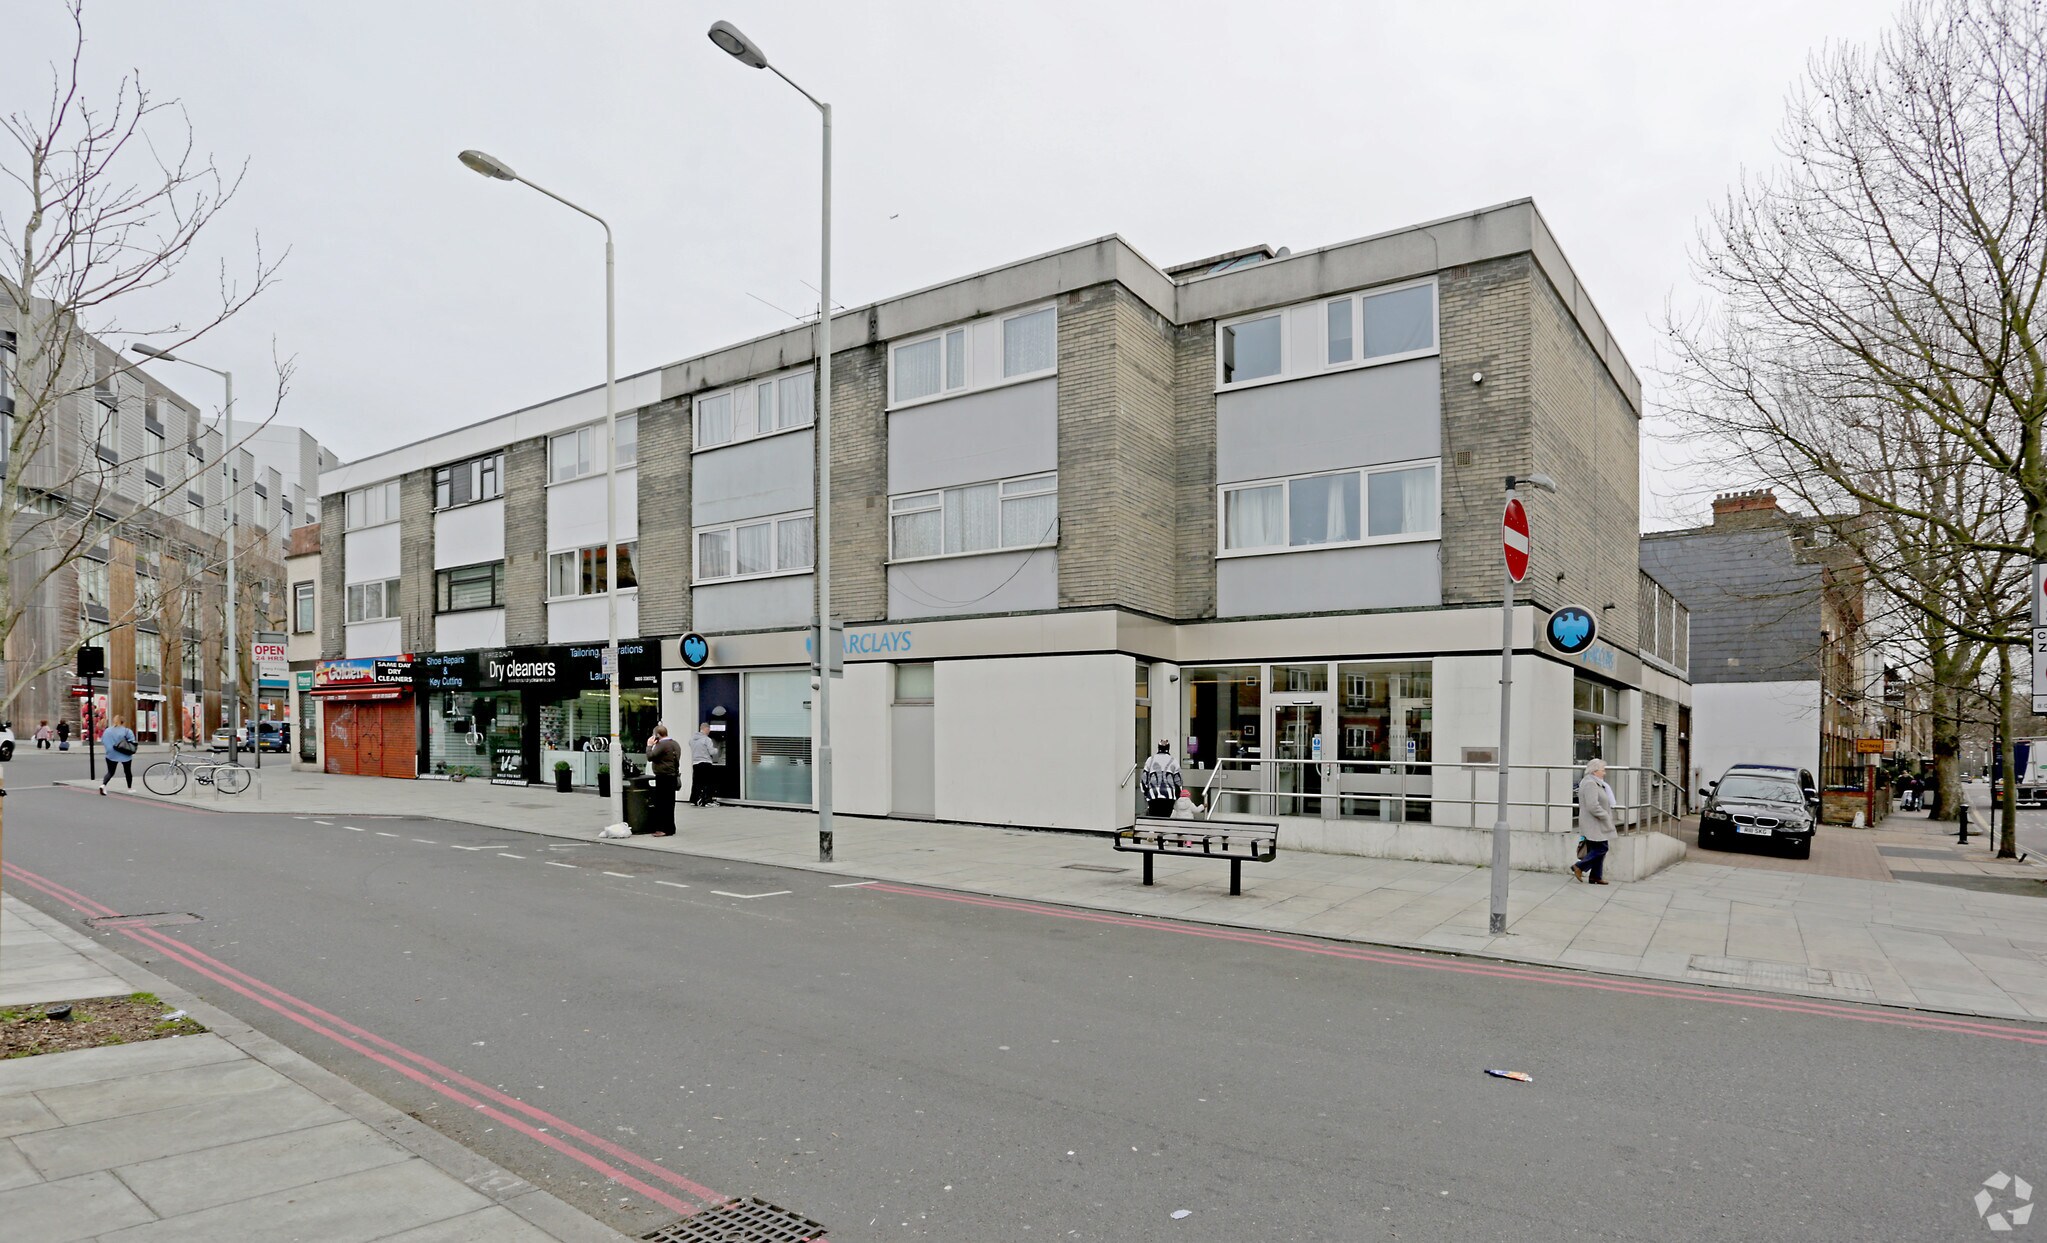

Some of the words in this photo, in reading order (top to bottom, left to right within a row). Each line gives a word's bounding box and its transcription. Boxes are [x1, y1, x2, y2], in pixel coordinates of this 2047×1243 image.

[843, 630, 912, 654] RCLAYS
[254, 645, 285, 655] OPEN
[617, 644, 643, 655] rations
[426, 656, 441, 666] Shoe
[443, 655, 465, 666] Repairs
[328, 662, 364, 680] Golden
[442, 666, 448, 675] &
[489, 660, 505, 682] Dry
[506, 659, 556, 677] cleaners
[377, 675, 413, 683] CLEANERS
[429, 678, 441, 688] Key
[442, 676, 463, 687] Cutting
